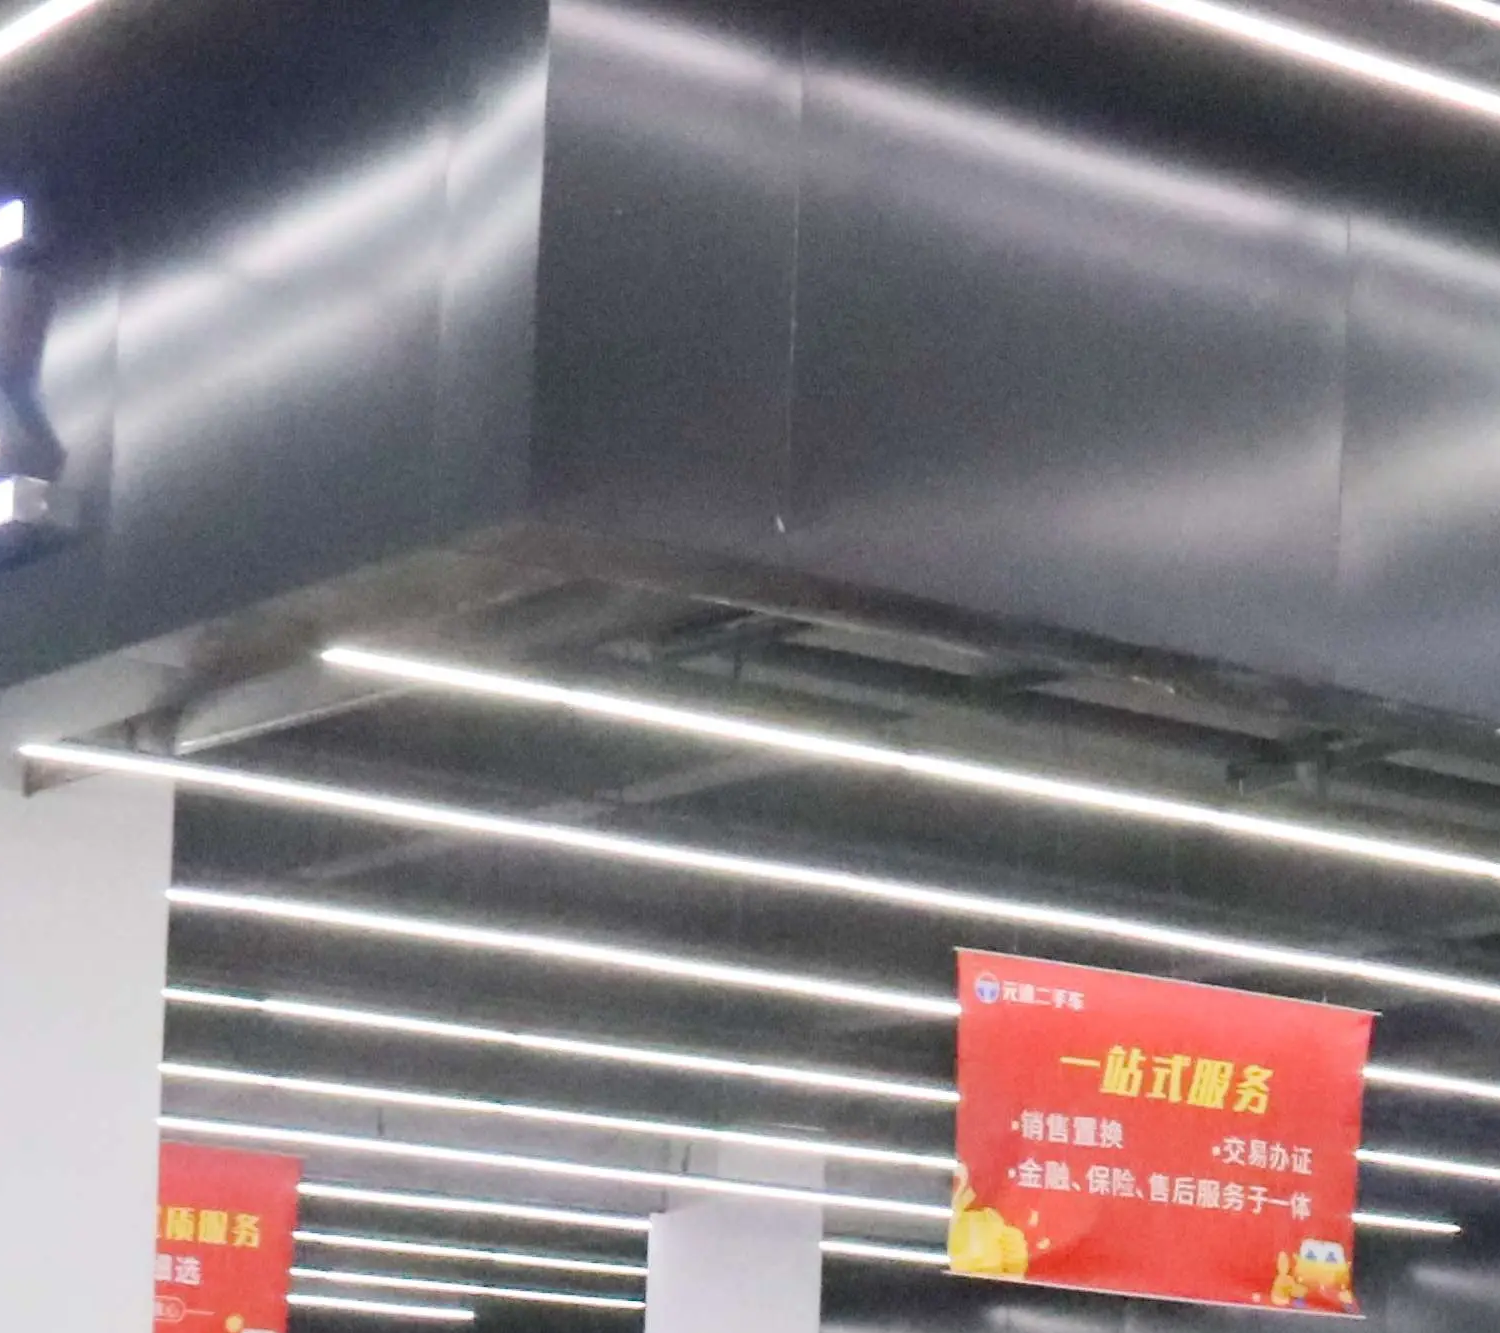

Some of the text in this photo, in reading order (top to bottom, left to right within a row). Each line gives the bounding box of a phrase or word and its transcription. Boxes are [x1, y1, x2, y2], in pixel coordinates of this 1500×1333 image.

[1060, 1044, 1274, 1115] 一站式服务
[1019, 1108, 1124, 1150] 销售置换
[1222, 1135, 1314, 1176] 交易办证
[156, 1203, 260, 1249] 质服务
